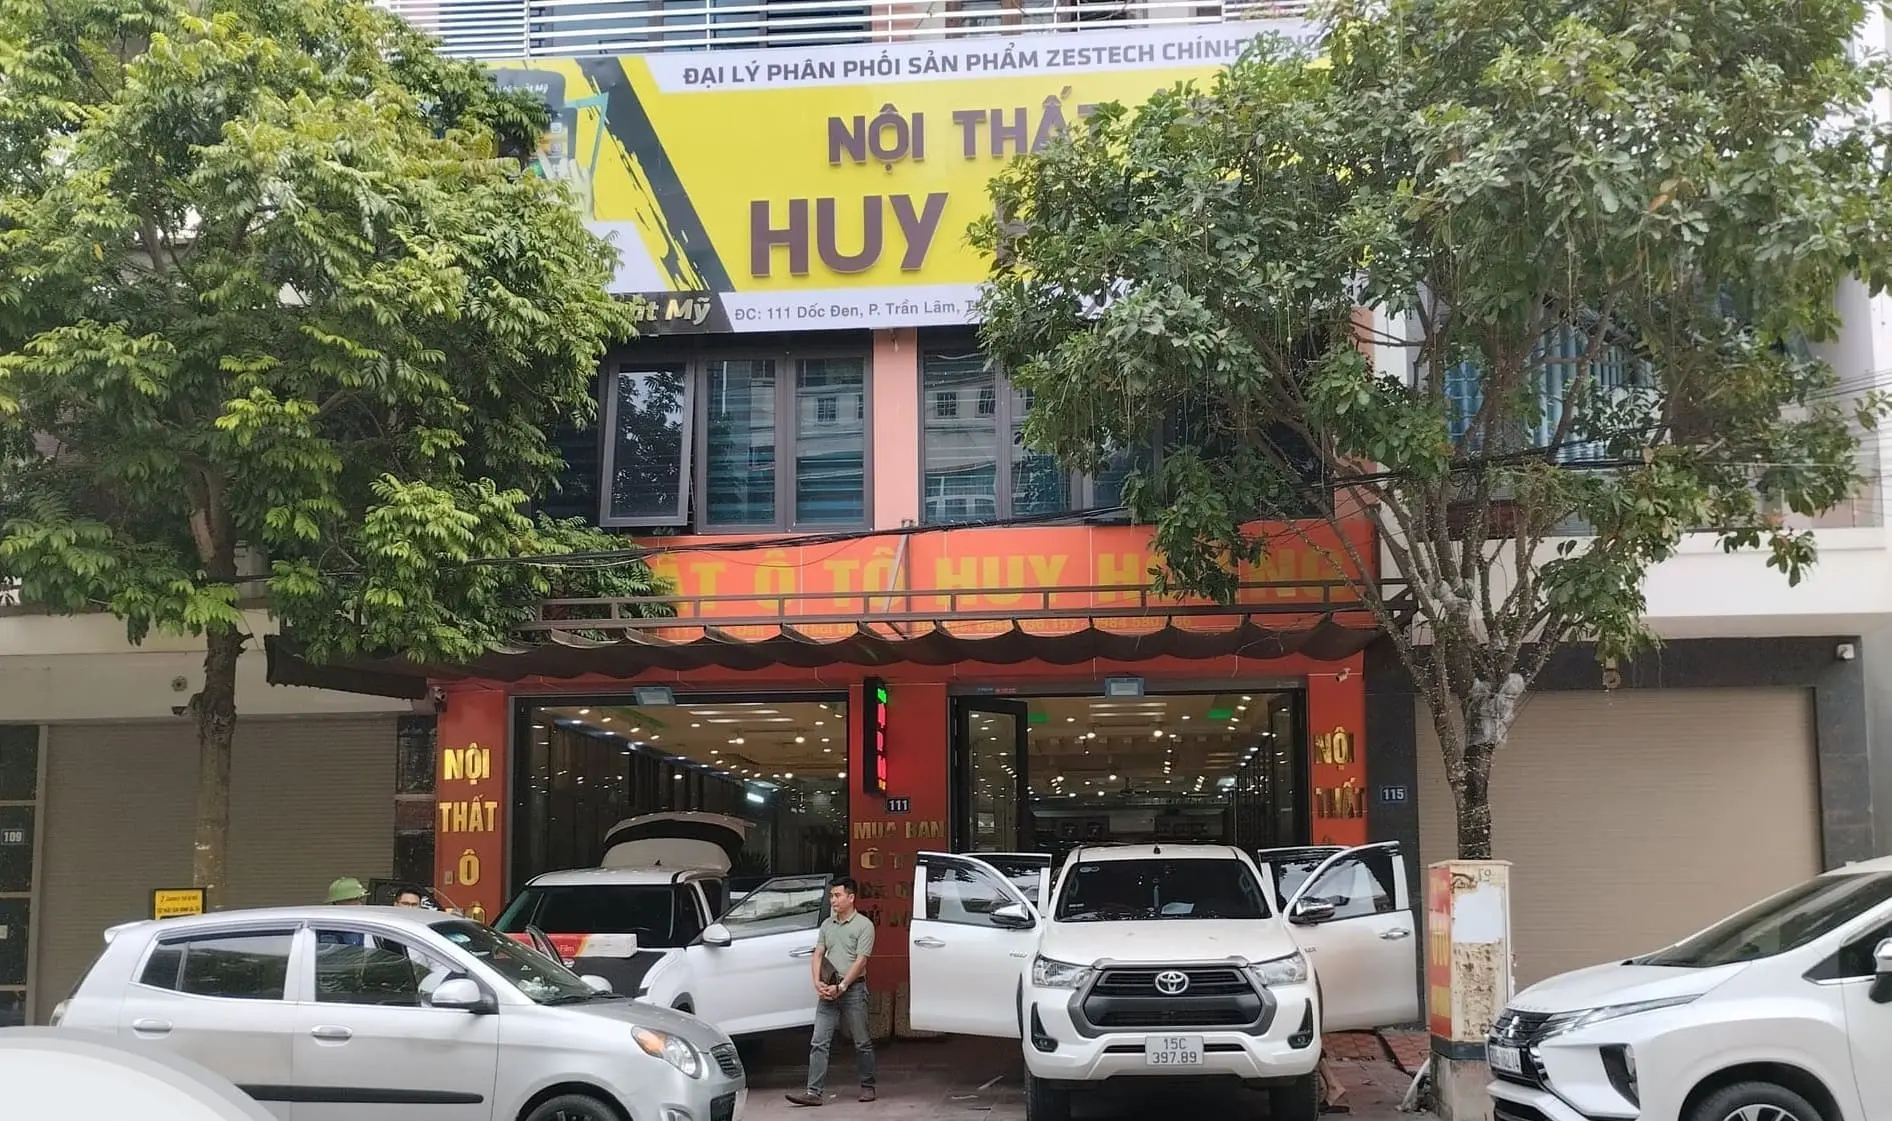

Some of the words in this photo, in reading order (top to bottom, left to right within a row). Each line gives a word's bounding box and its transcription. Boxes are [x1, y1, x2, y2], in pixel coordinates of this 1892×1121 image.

[683, 67, 724, 88] ĐẠI
[732, 60, 760, 83] LÝ
[767, 59, 835, 81] PHÂN
[843, 50, 900, 77] PHỐI
[908, 50, 958, 74] SẢN
[966, 42, 1038, 71] PHẨM
[1046, 43, 1154, 67] ZESTECH
[1162, 36, 1241, 60] CHÍNH
[828, 103, 925, 173] NỘI
[750, 192, 950, 277] HUY
[665, 297, 711, 325] Mỹ
[735, 309, 762, 321] ĐC:
[768, 308, 791, 319] 111
[797, 303, 825, 318] Dốc
[831, 305, 864, 318] Đen,
[869, 304, 880, 316] P.
[886, 299, 918, 314] Trần
[755, 548, 795, 611] Ô
[825, 547, 905, 608] TÔ
[936, 554, 1068, 607] HUY
[444, 743, 490, 785] NỘI
[889, 800, 908, 811] 111
[1383, 789, 1404, 800] 115
[439, 793, 498, 833] THẤT
[4, 831, 22, 842] 109
[459, 848, 480, 886] Ô
[1152, 1051, 1197, 1063] 397.89
[1164, 1038, 1186, 1049] 15C
